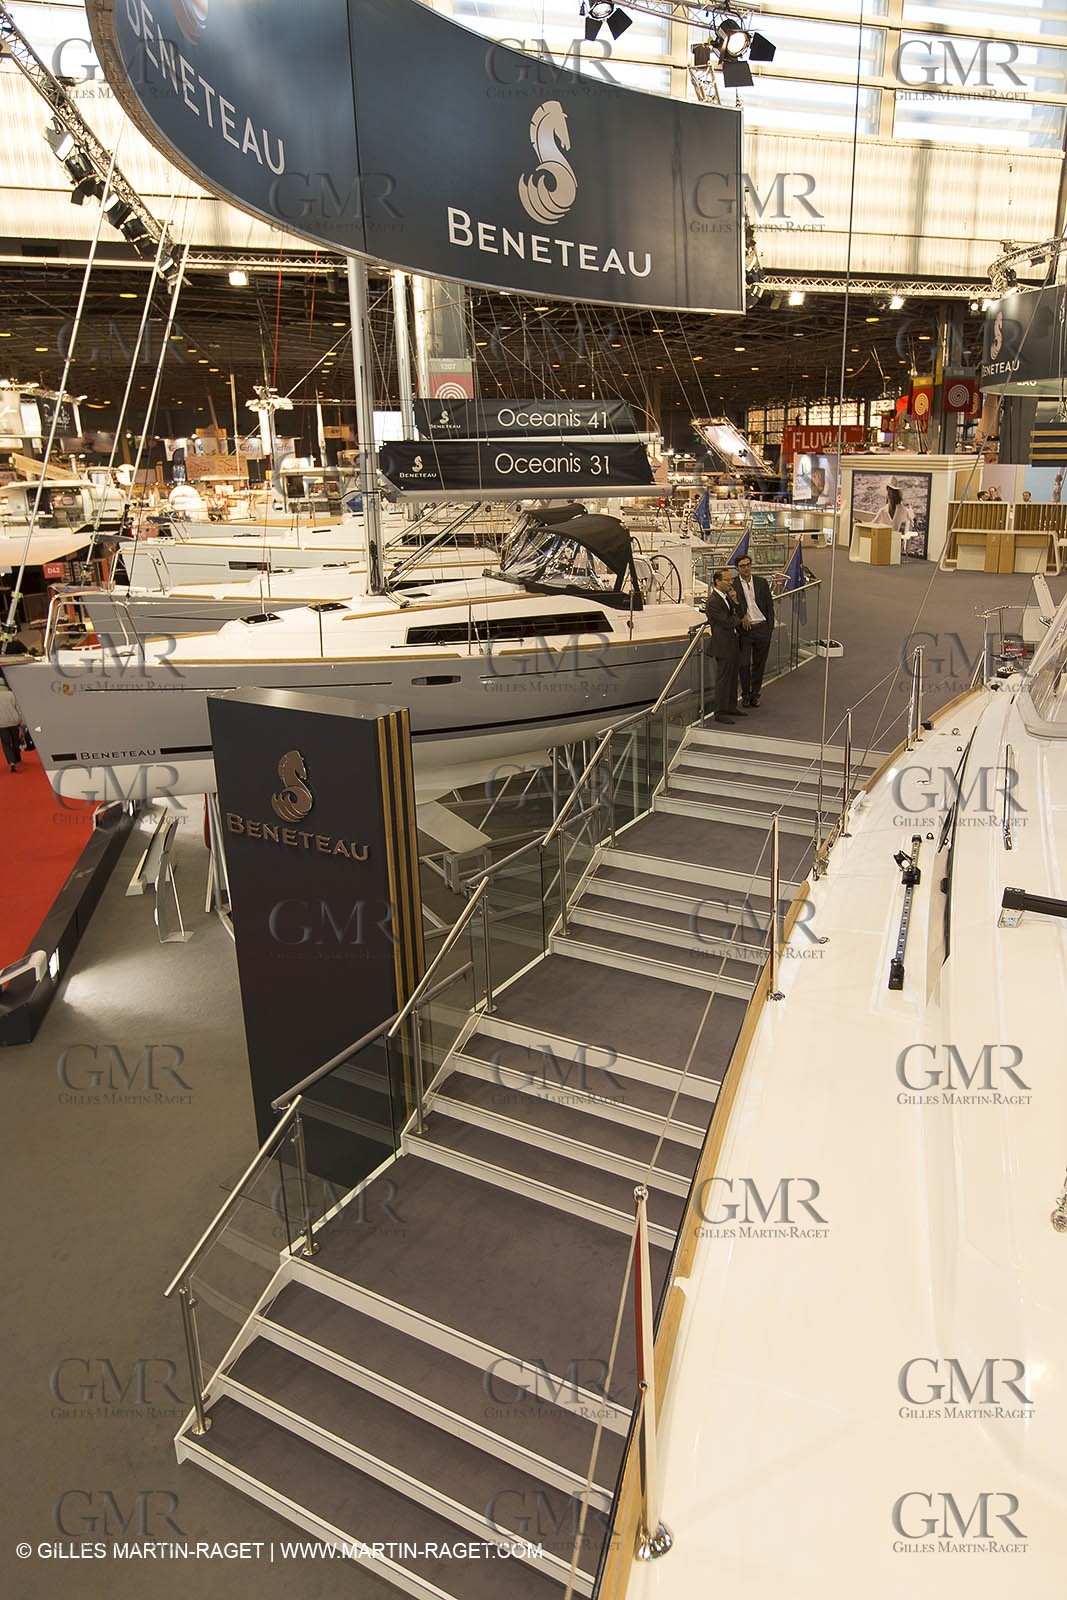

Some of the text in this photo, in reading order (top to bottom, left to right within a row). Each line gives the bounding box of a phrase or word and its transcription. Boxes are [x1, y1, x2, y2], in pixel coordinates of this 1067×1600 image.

[447, 206, 652, 277] BENETEAU
[497, 408, 608, 429] Oceanis 41
[494, 452, 610, 475] Oceanis 31
[80, 749, 157, 760] BENETEAU
[226, 812, 369, 862] BENETEAU
